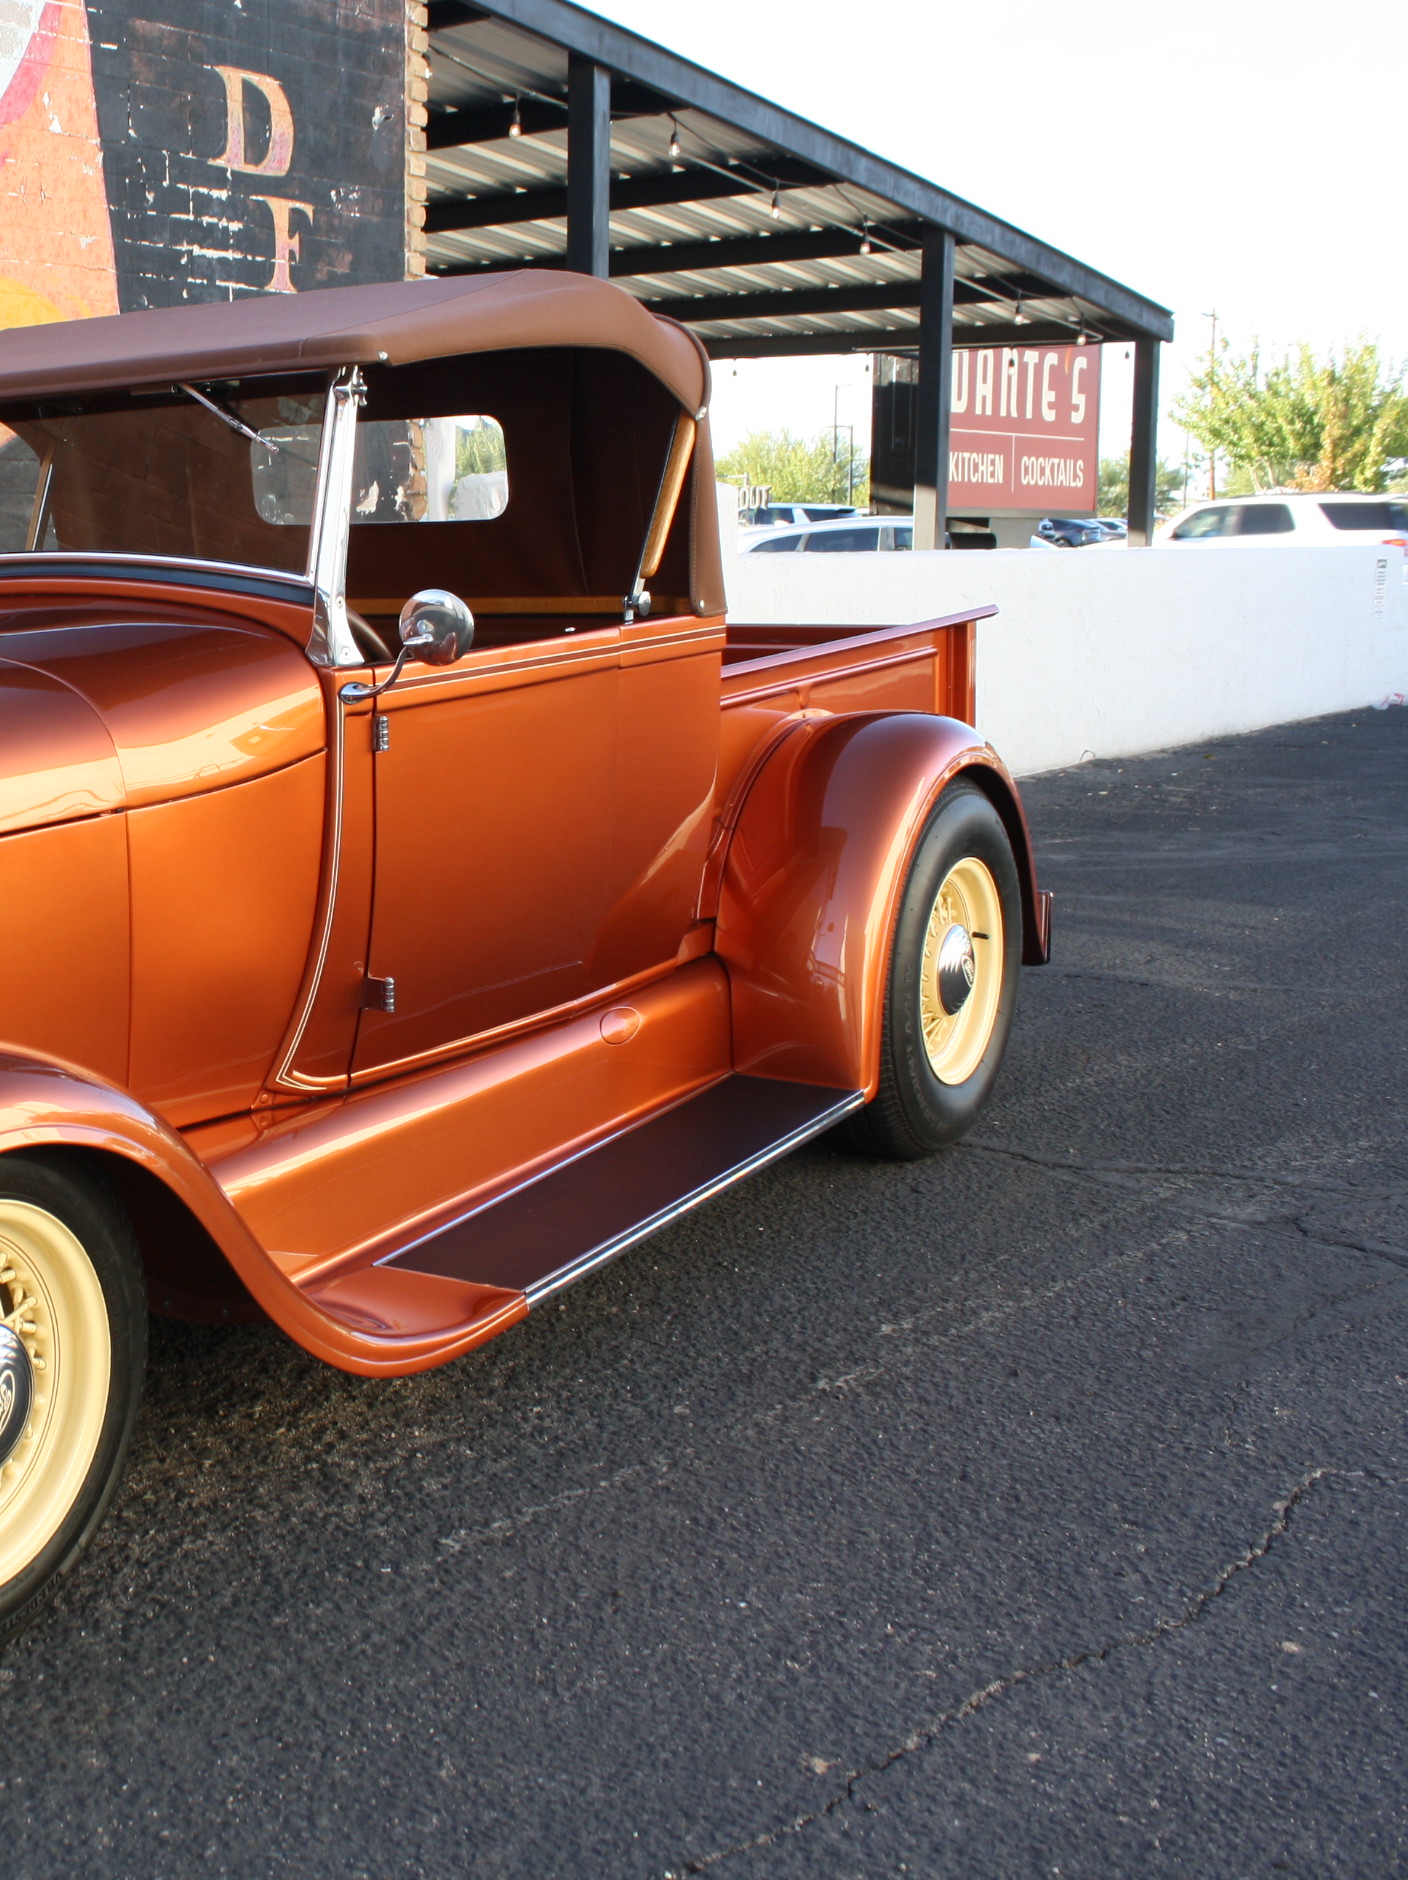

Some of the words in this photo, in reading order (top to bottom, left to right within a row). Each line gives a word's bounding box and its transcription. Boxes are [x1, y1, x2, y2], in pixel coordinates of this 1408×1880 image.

[207, 64, 295, 177] D
[263, 196, 315, 294] F
[948, 451, 1004, 484] KITCHEN
[1021, 455, 1084, 488] COCKTAILS
